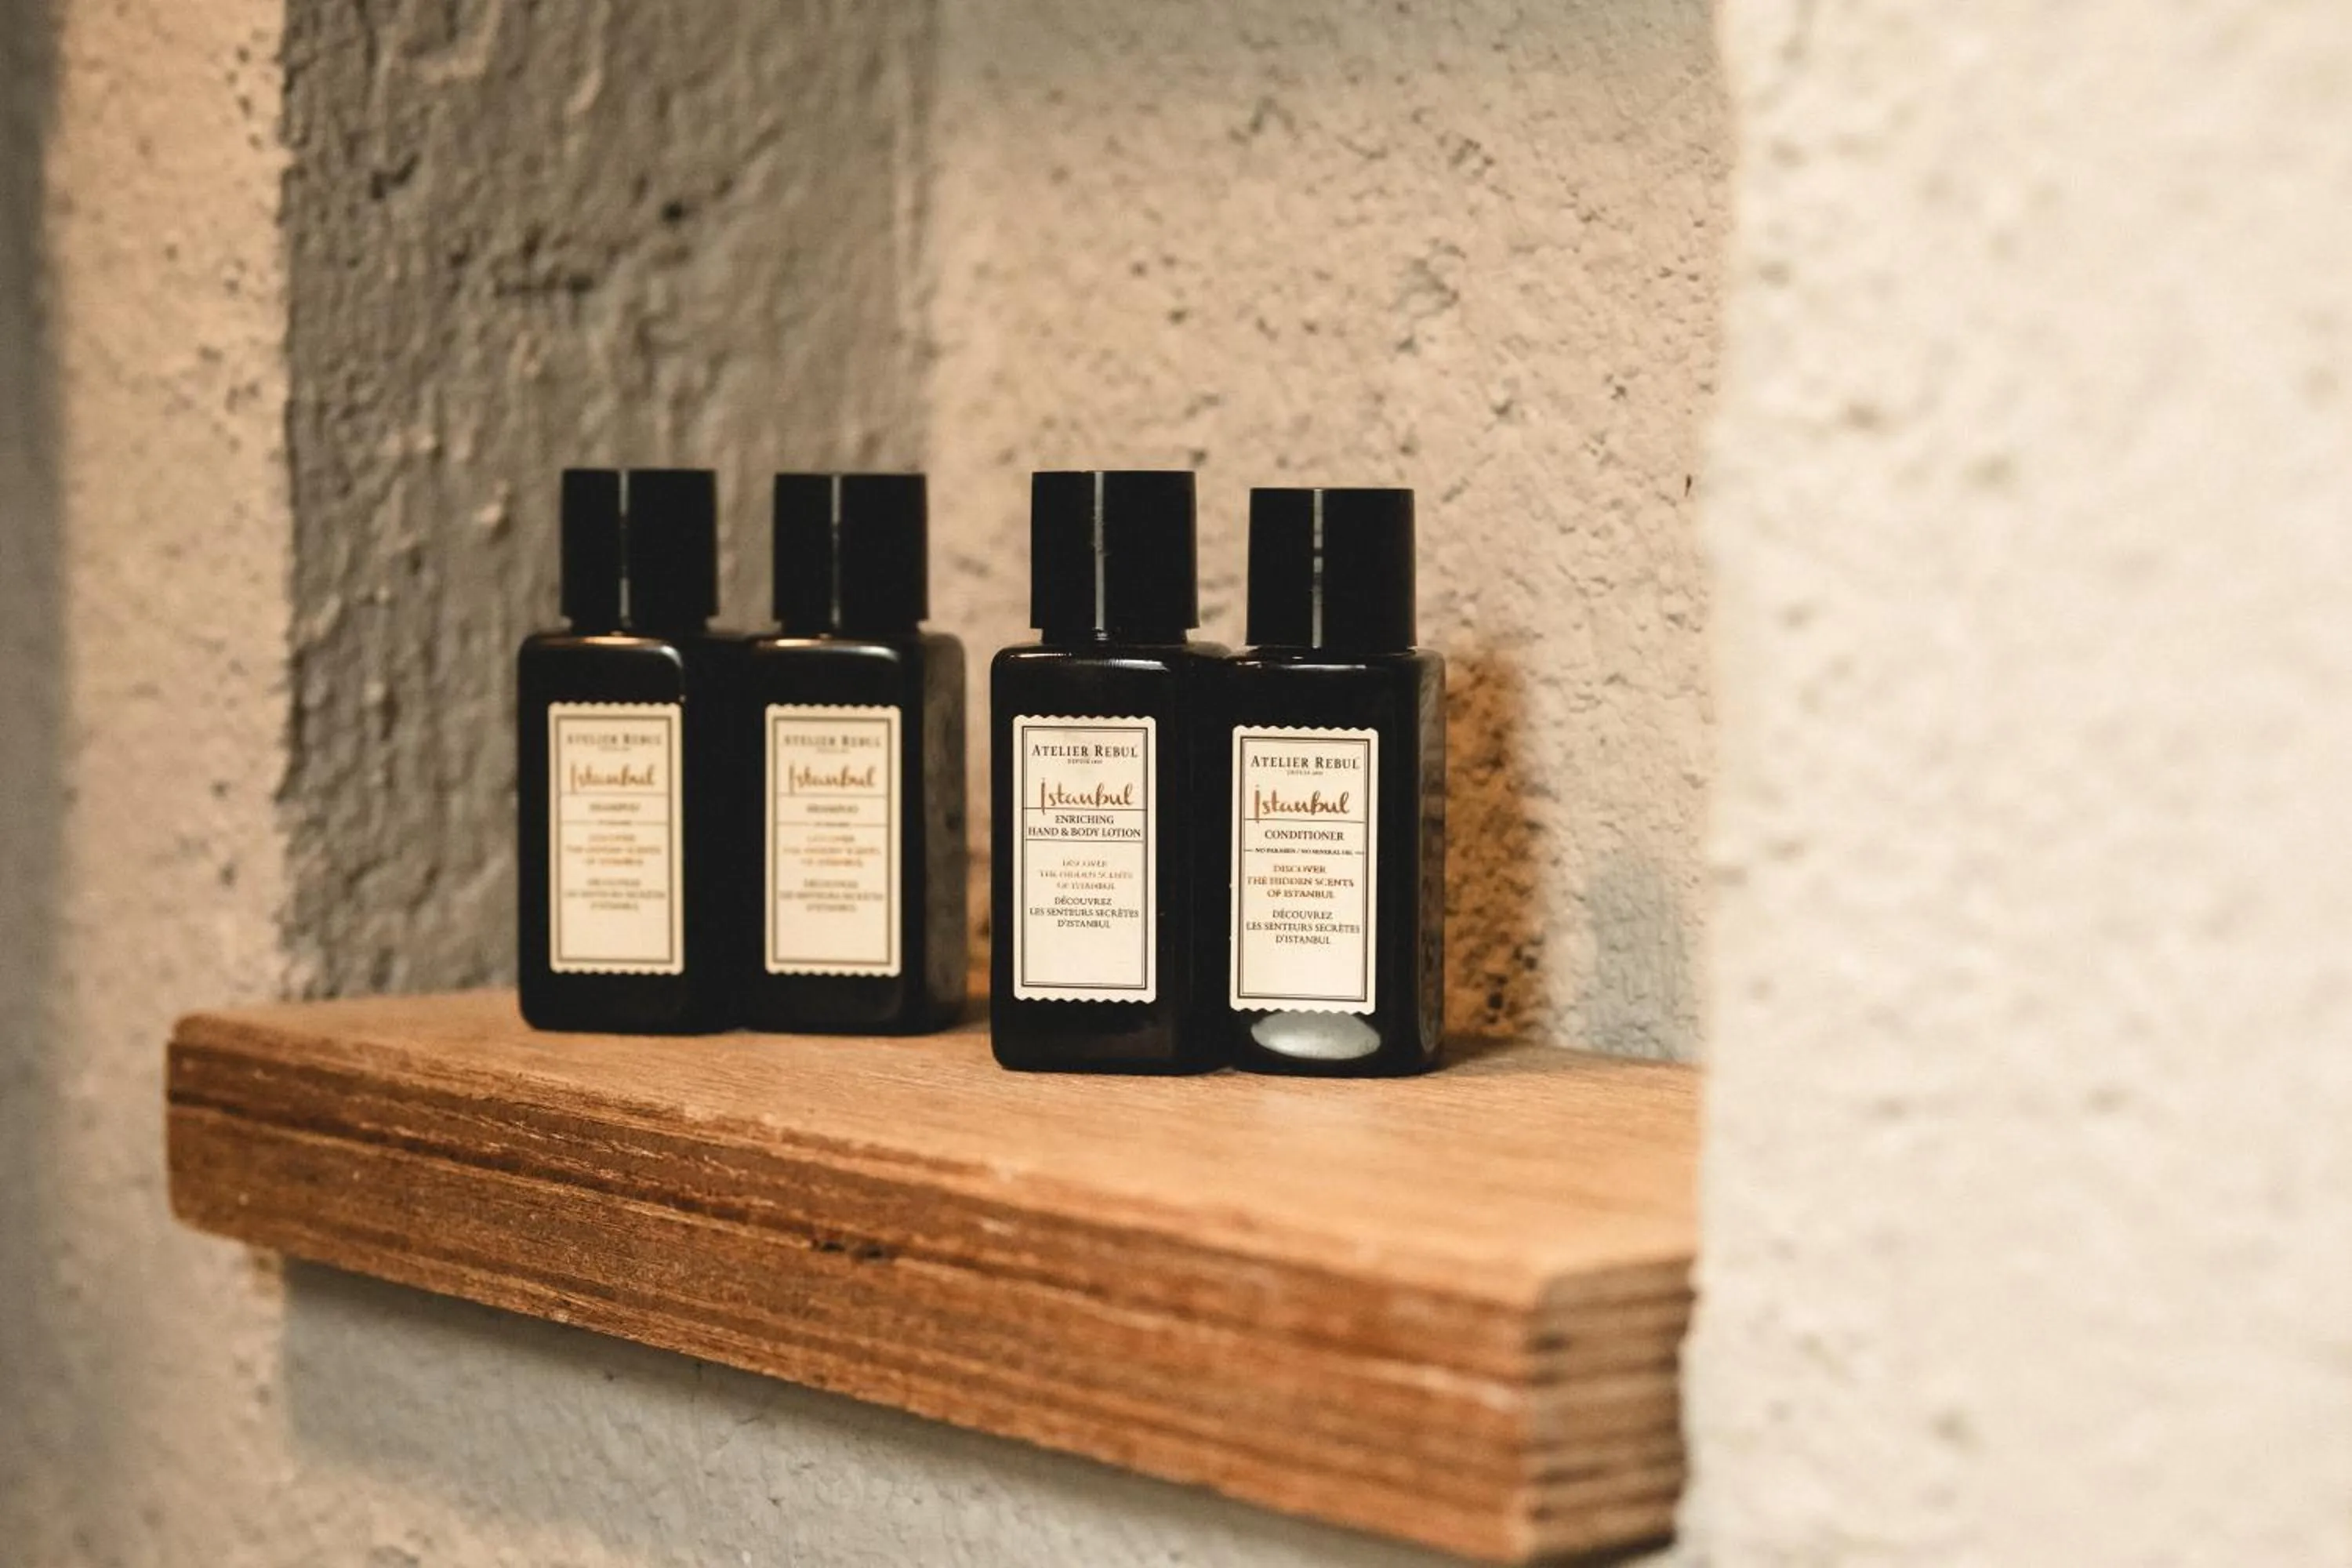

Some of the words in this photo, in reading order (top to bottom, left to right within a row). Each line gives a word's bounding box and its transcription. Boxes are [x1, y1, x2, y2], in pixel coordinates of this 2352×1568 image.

[1032, 745, 1088, 757] ATELIER
[1095, 745, 1138, 758] REBUL
[1250, 756, 1308, 768] ATELIER
[1315, 757, 1360, 770] REBUL
[1054, 815, 1114, 824] ENRICHING
[1028, 826, 1058, 837] HAND
[1061, 827, 1069, 837] &
[1070, 828, 1099, 837] BODY
[1102, 828, 1141, 837] LOTION
[1265, 829, 1345, 841] CONDITIONER
[1273, 865, 1327, 873] DISCOVER
[1247, 877, 1268, 885] THE
[1269, 877, 1312, 886] HIDDEN
[1315, 877, 1355, 887] SCENTS
[1283, 890, 1334, 898] ISTANBUL
[1047, 908, 1093, 916] SENTEURS
[1247, 921, 1261, 931] LES
[1265, 922, 1312, 931] SENTEURS
